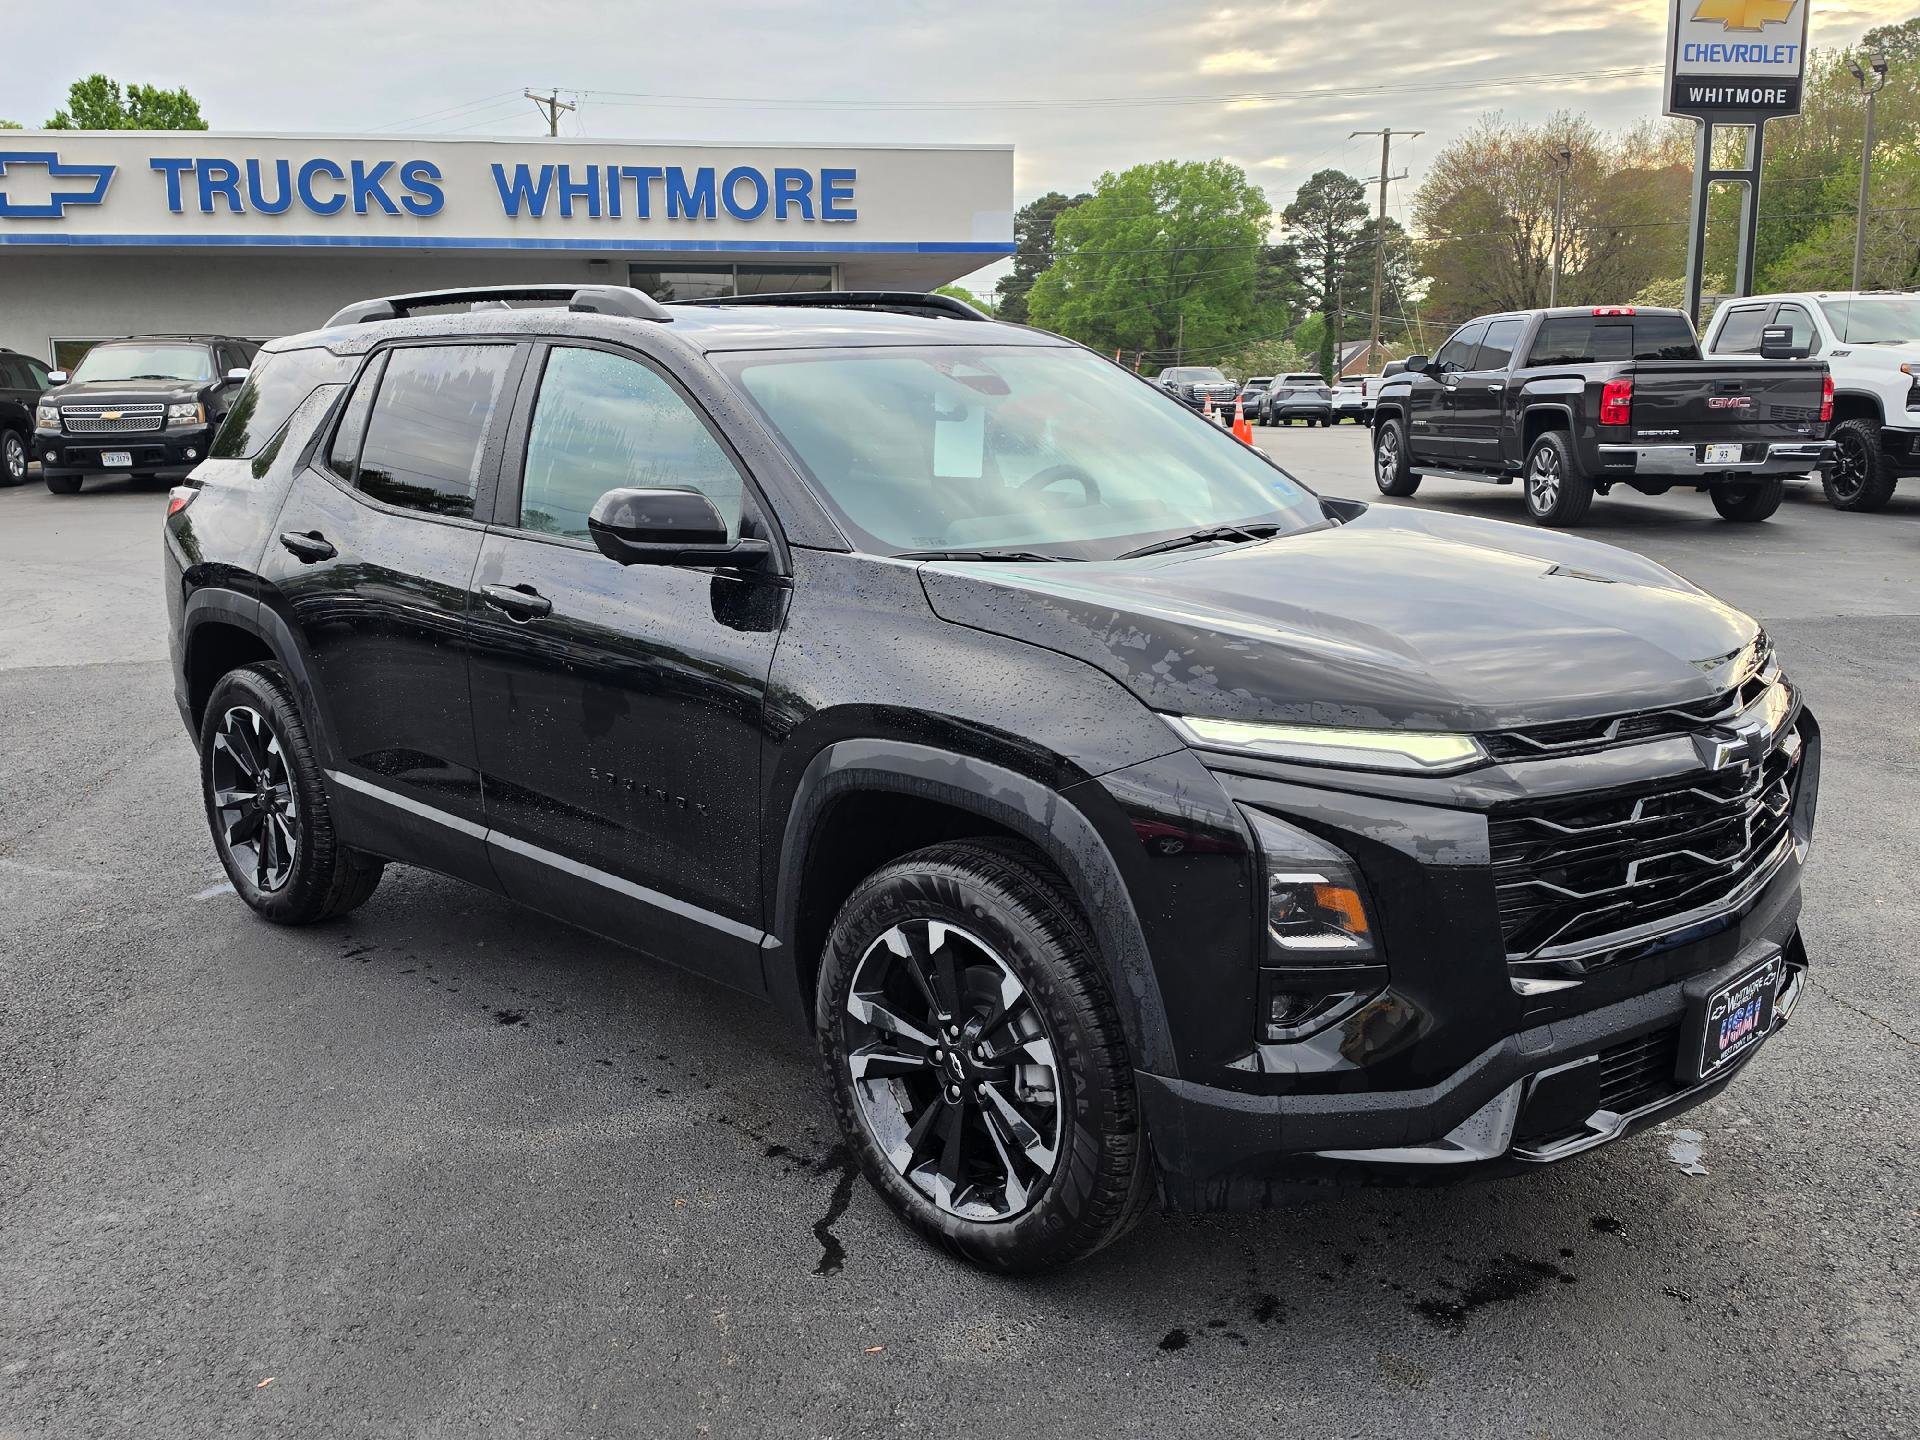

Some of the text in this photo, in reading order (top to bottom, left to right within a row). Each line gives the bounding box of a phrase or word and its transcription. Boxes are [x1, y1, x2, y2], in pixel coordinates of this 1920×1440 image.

[1684, 43, 1798, 64] CHEVROLET
[1689, 87, 1787, 104] WHITMORE
[149, 157, 859, 222] TRUCKS WHITMORE
[1708, 396, 1751, 409] GMC
